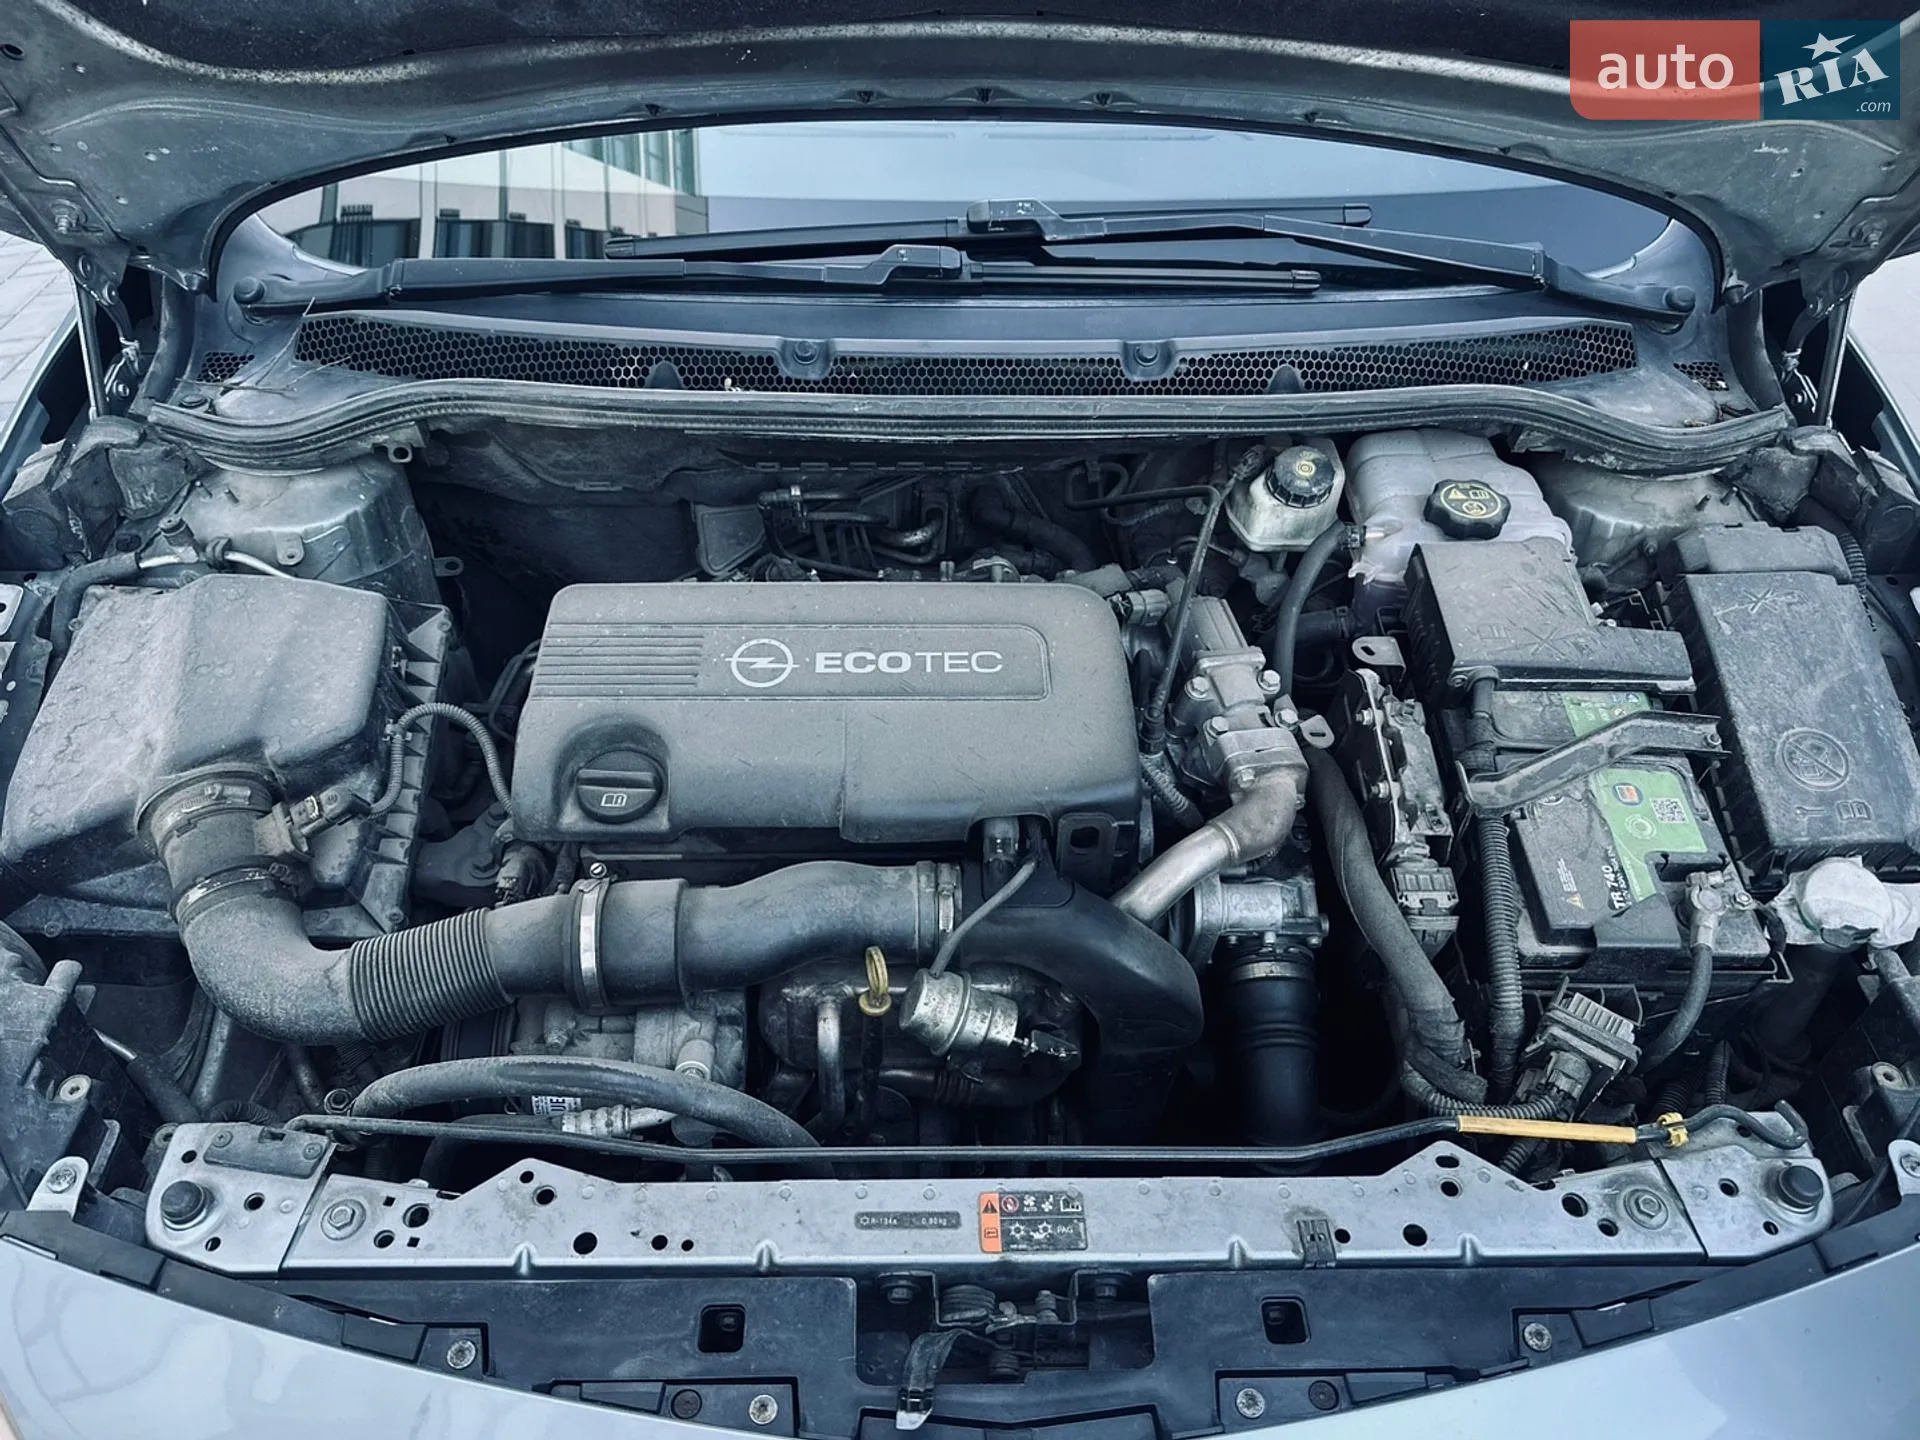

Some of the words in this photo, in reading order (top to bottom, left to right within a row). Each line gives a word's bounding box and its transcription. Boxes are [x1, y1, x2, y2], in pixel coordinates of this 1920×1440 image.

[815, 651, 1003, 673] ECOTEC
[1610, 891, 1626, 909] TR
[1057, 1225, 1074, 1234] PAG
